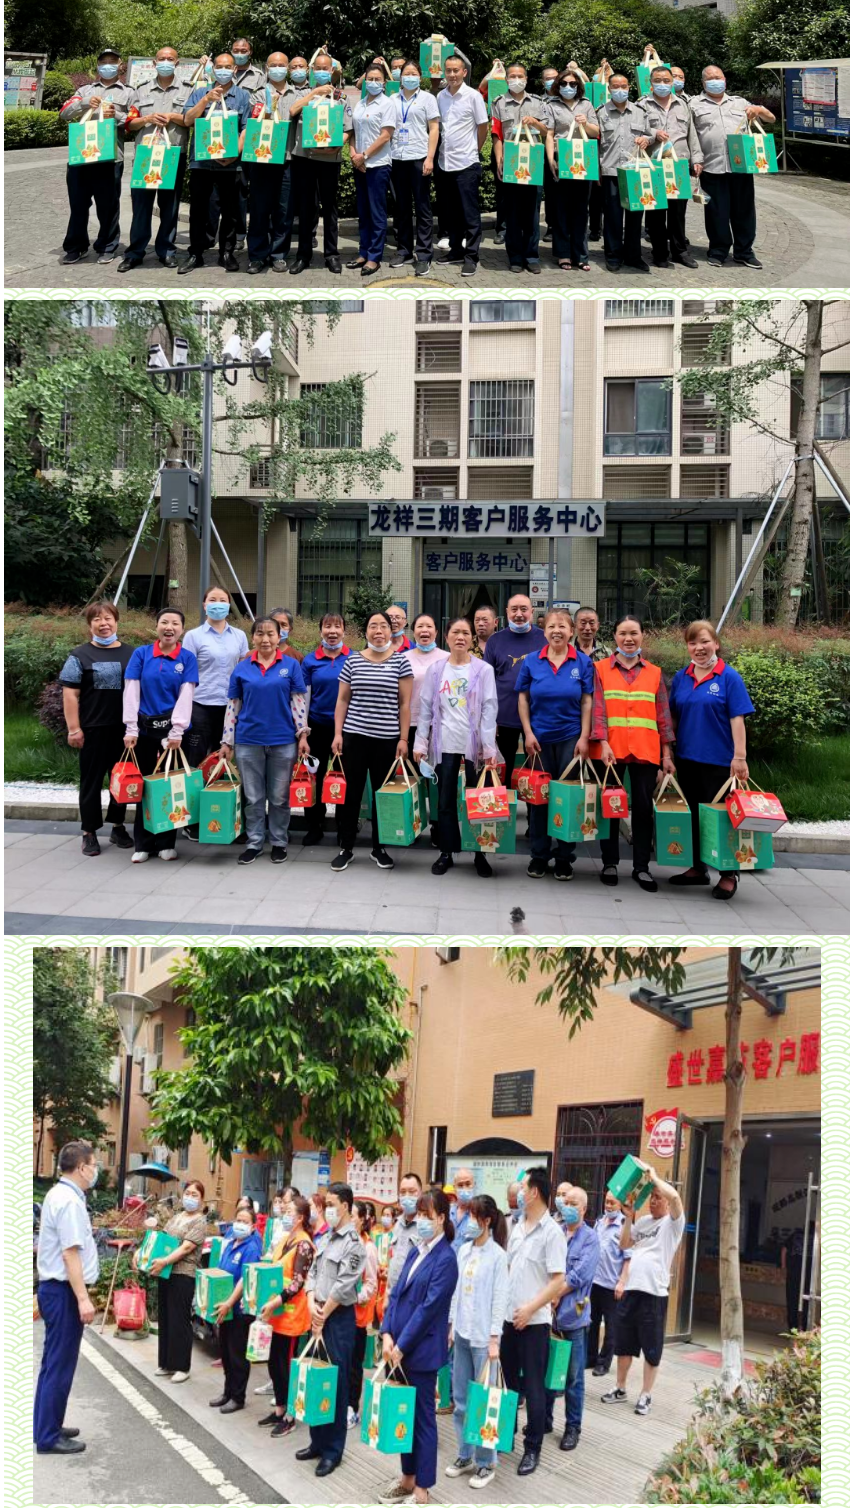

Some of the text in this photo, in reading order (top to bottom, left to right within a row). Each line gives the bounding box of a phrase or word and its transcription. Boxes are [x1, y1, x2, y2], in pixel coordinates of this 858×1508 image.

[370, 504, 603, 534] 龙祥三期客户服务中心
[426, 551, 529, 573] 客户服务中心
